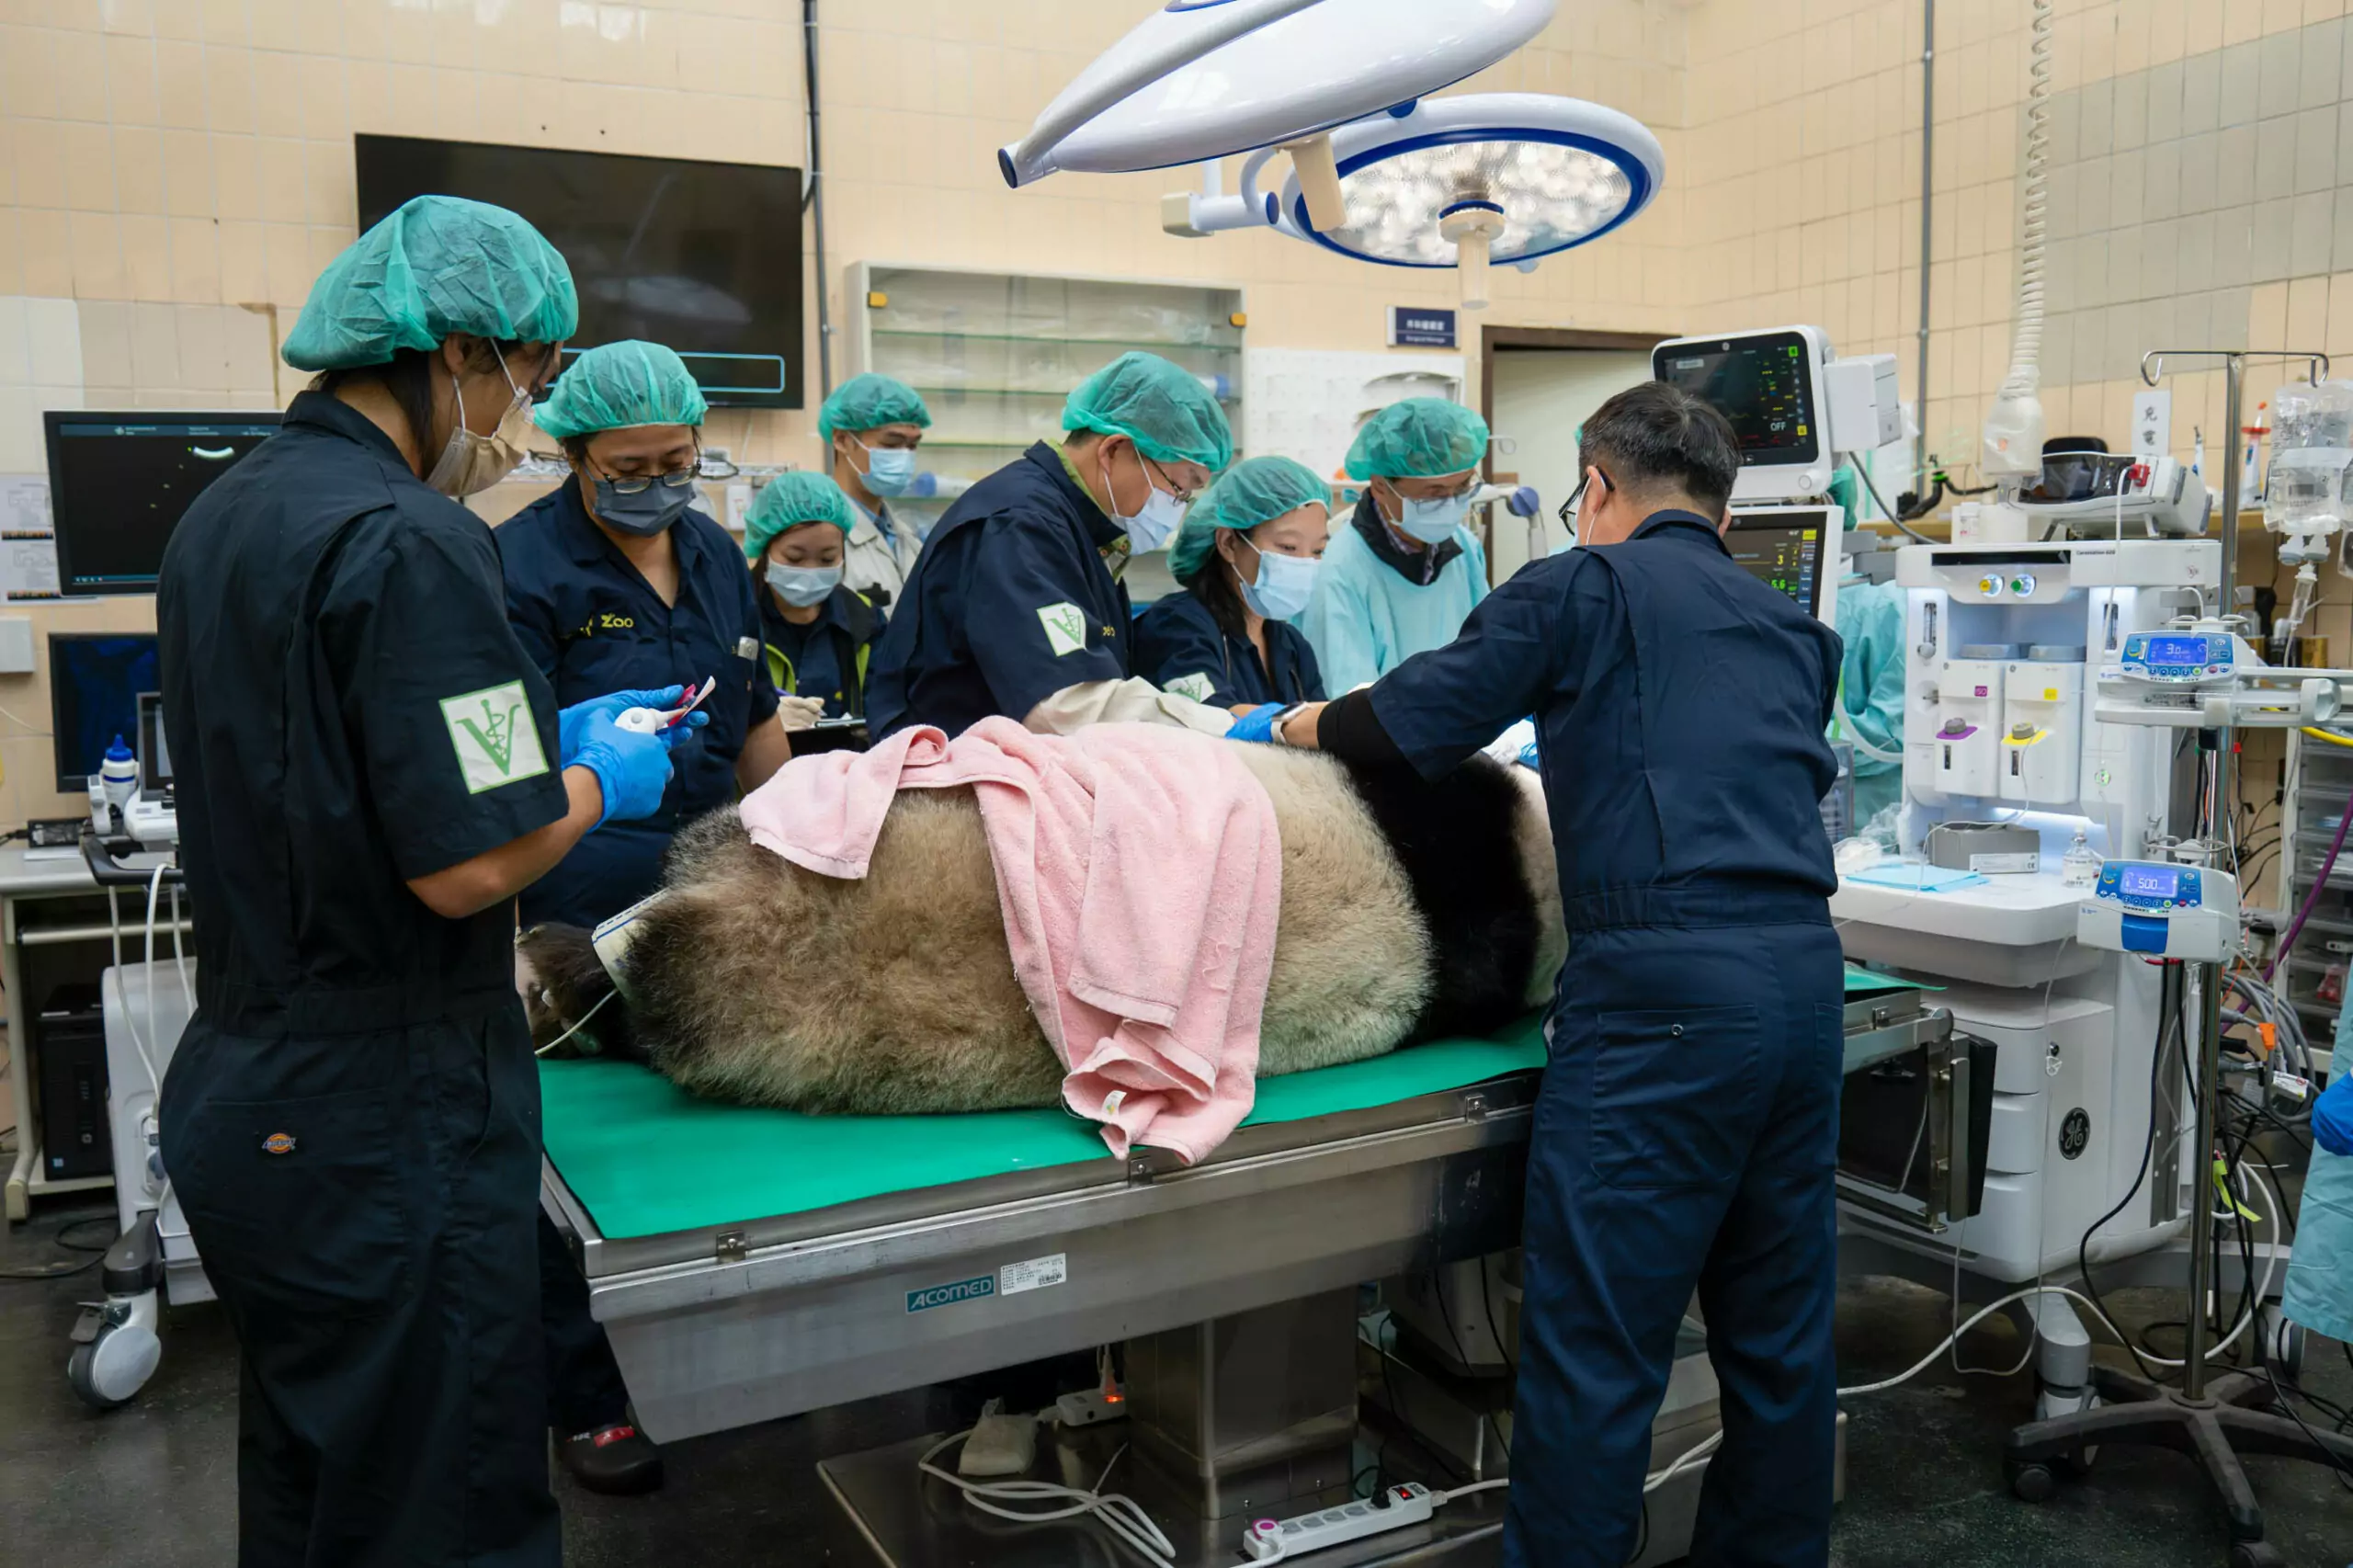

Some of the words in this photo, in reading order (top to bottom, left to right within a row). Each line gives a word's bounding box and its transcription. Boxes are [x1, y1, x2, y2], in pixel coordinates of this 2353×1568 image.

[1770, 422, 1786, 431] OFF
[600, 612, 634, 629] Zoo
[2138, 878, 2158, 890] 500
